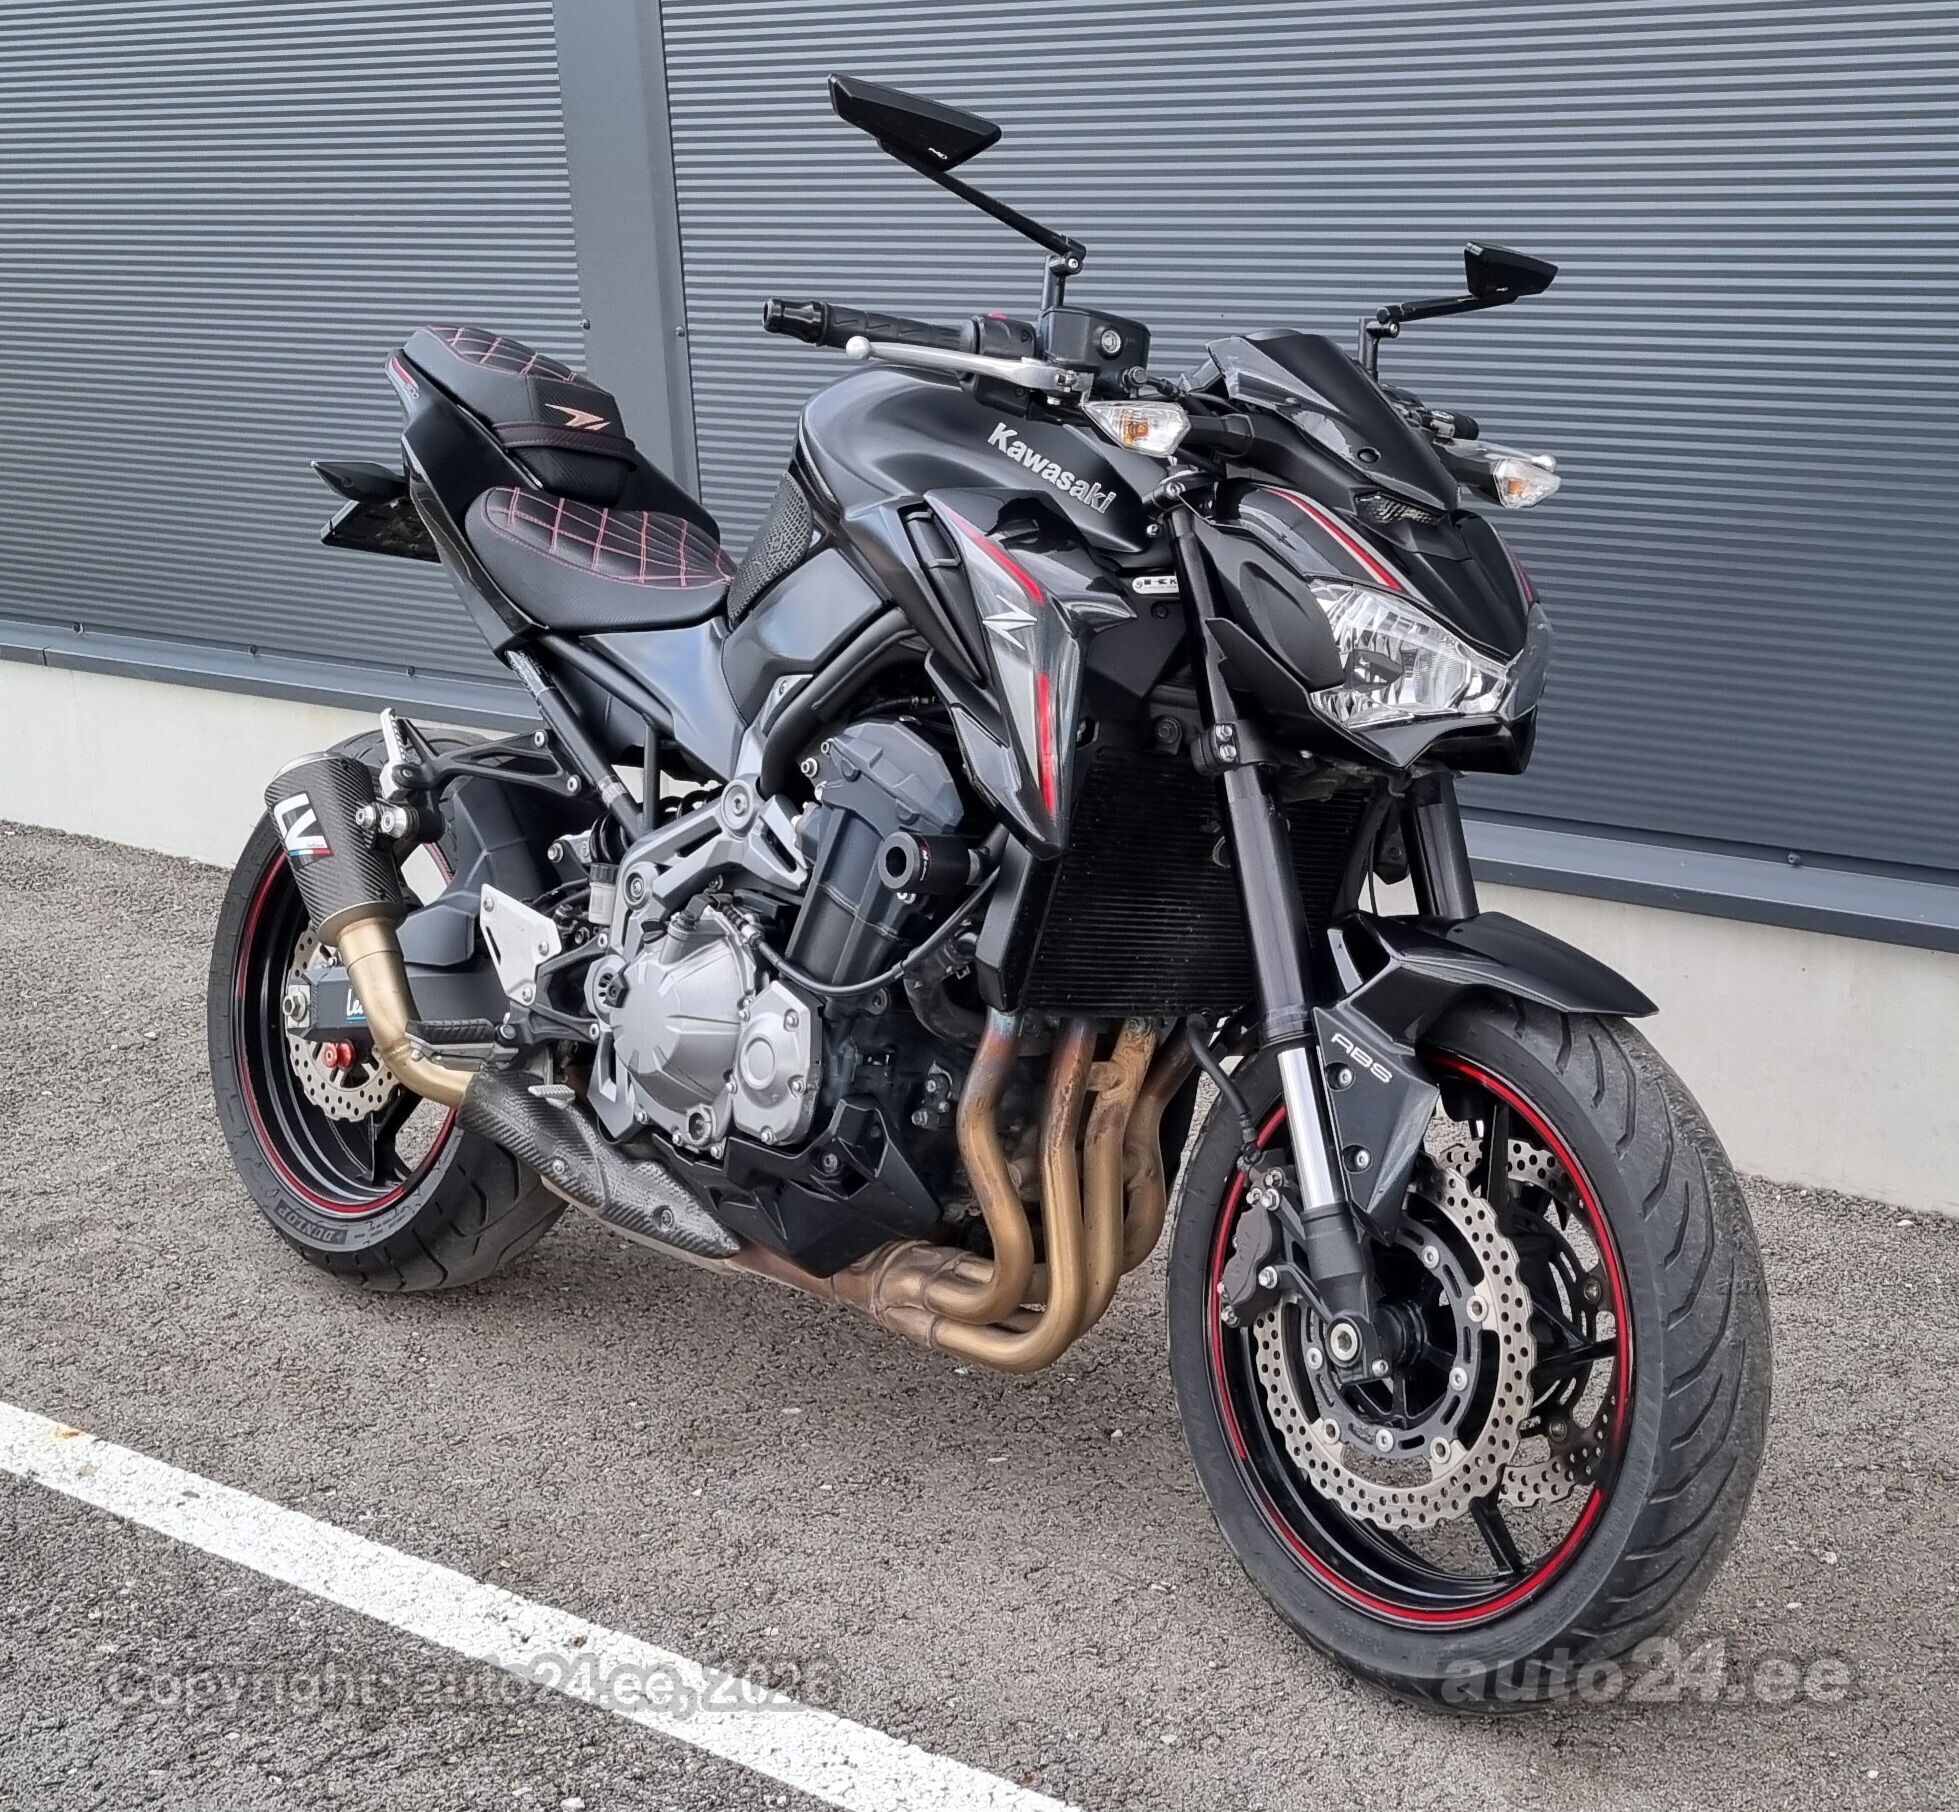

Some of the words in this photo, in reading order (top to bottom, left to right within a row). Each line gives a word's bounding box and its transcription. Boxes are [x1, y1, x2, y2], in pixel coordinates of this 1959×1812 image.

[987, 422, 1117, 514] Kawasaki
[1331, 1033, 1393, 1083] ABS
[277, 1206, 336, 1243] DUNLOP
